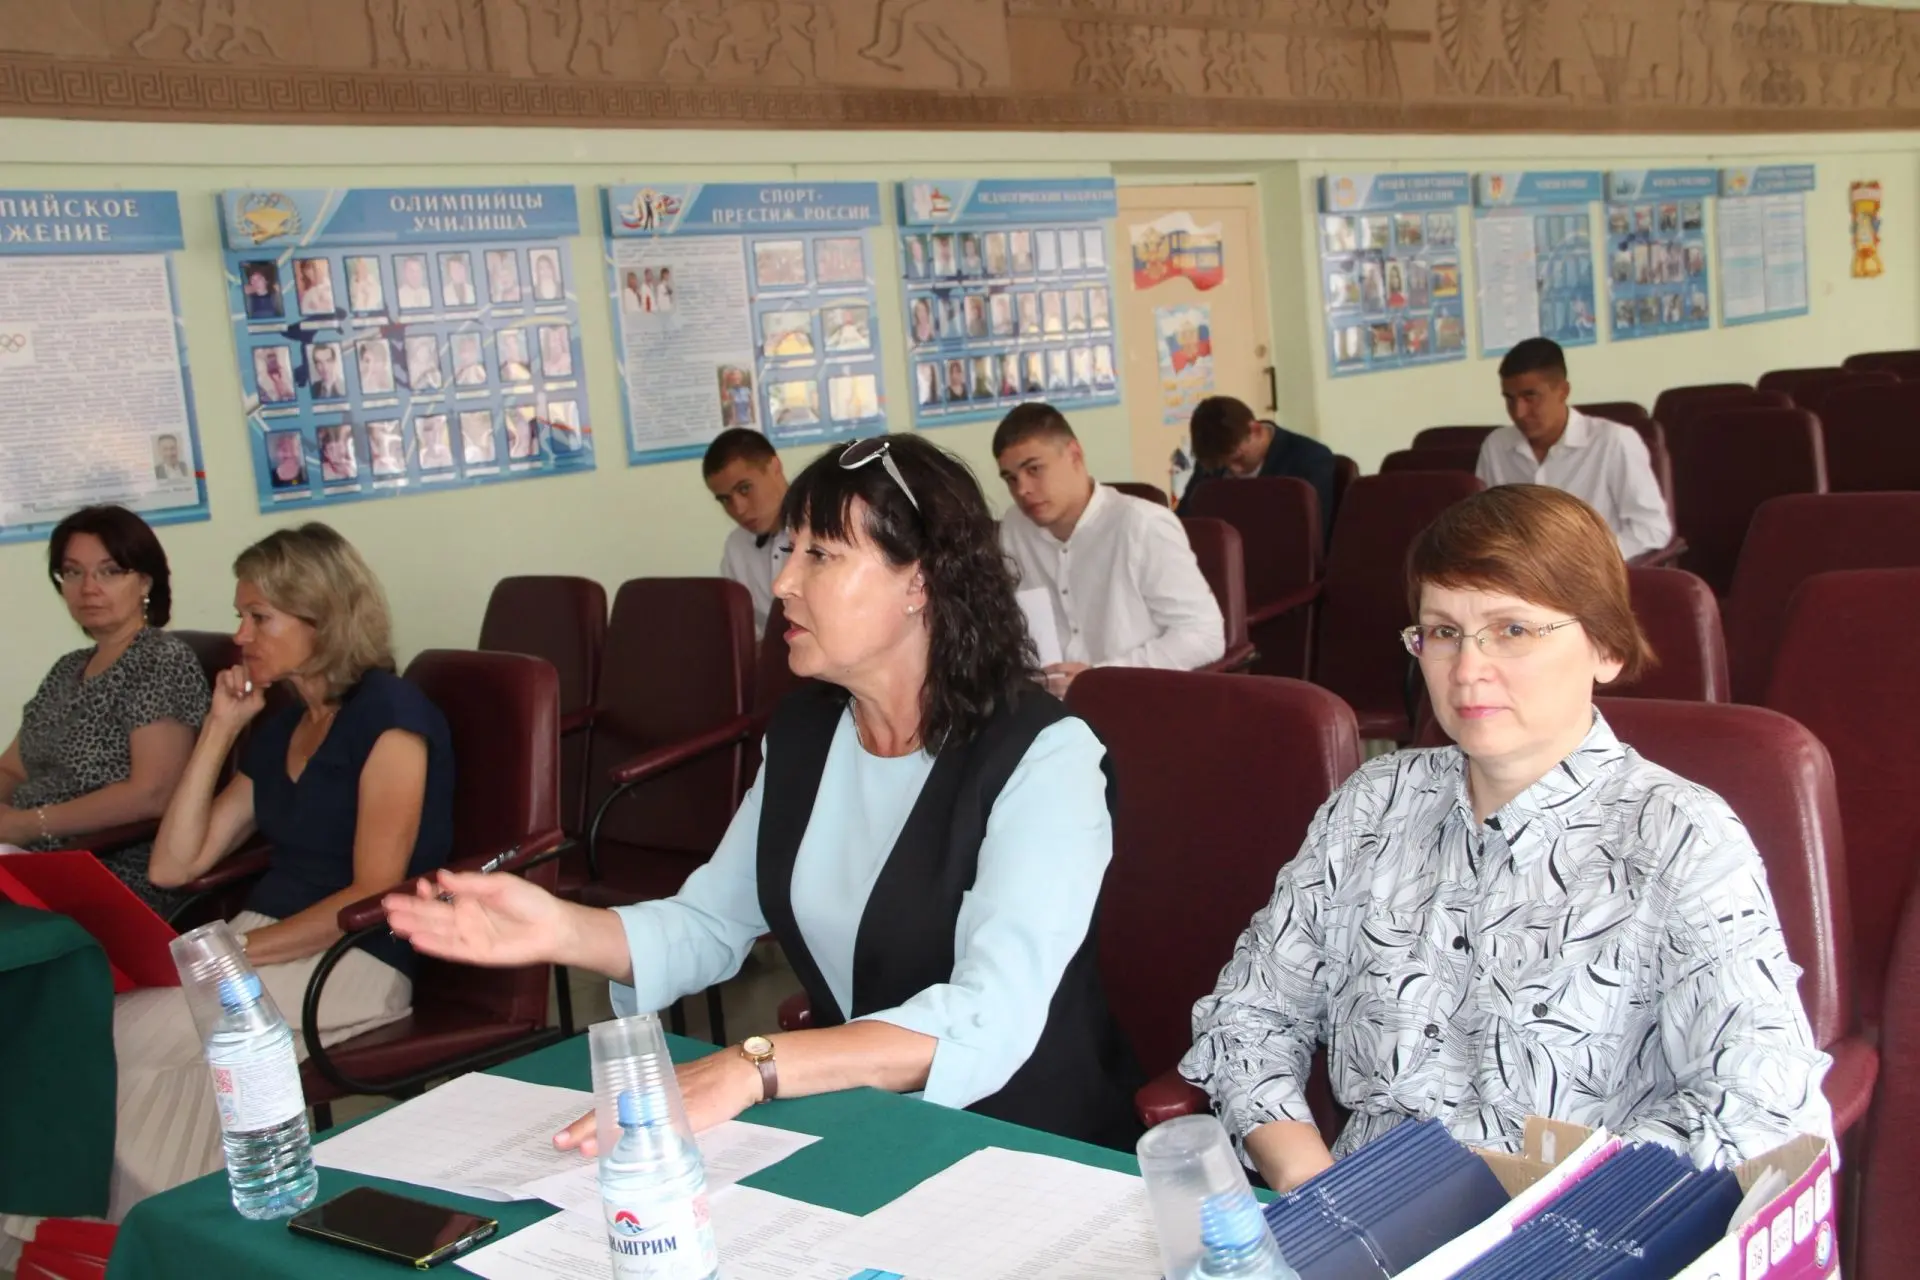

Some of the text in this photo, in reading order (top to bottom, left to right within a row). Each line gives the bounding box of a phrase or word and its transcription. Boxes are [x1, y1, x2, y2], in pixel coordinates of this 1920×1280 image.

[0, 193, 139, 217] ПИЙСКОЕ
[391, 192, 543, 213] ОЛИМПИЙЦЫ
[760, 188, 823, 204] СПОРТ-
[712, 205, 870, 223] ПРЕСТИЖ РОССИИ
[413, 215, 527, 232] УЧИЛИЩА
[0, 224, 112, 242] ЖЕНИЕ
